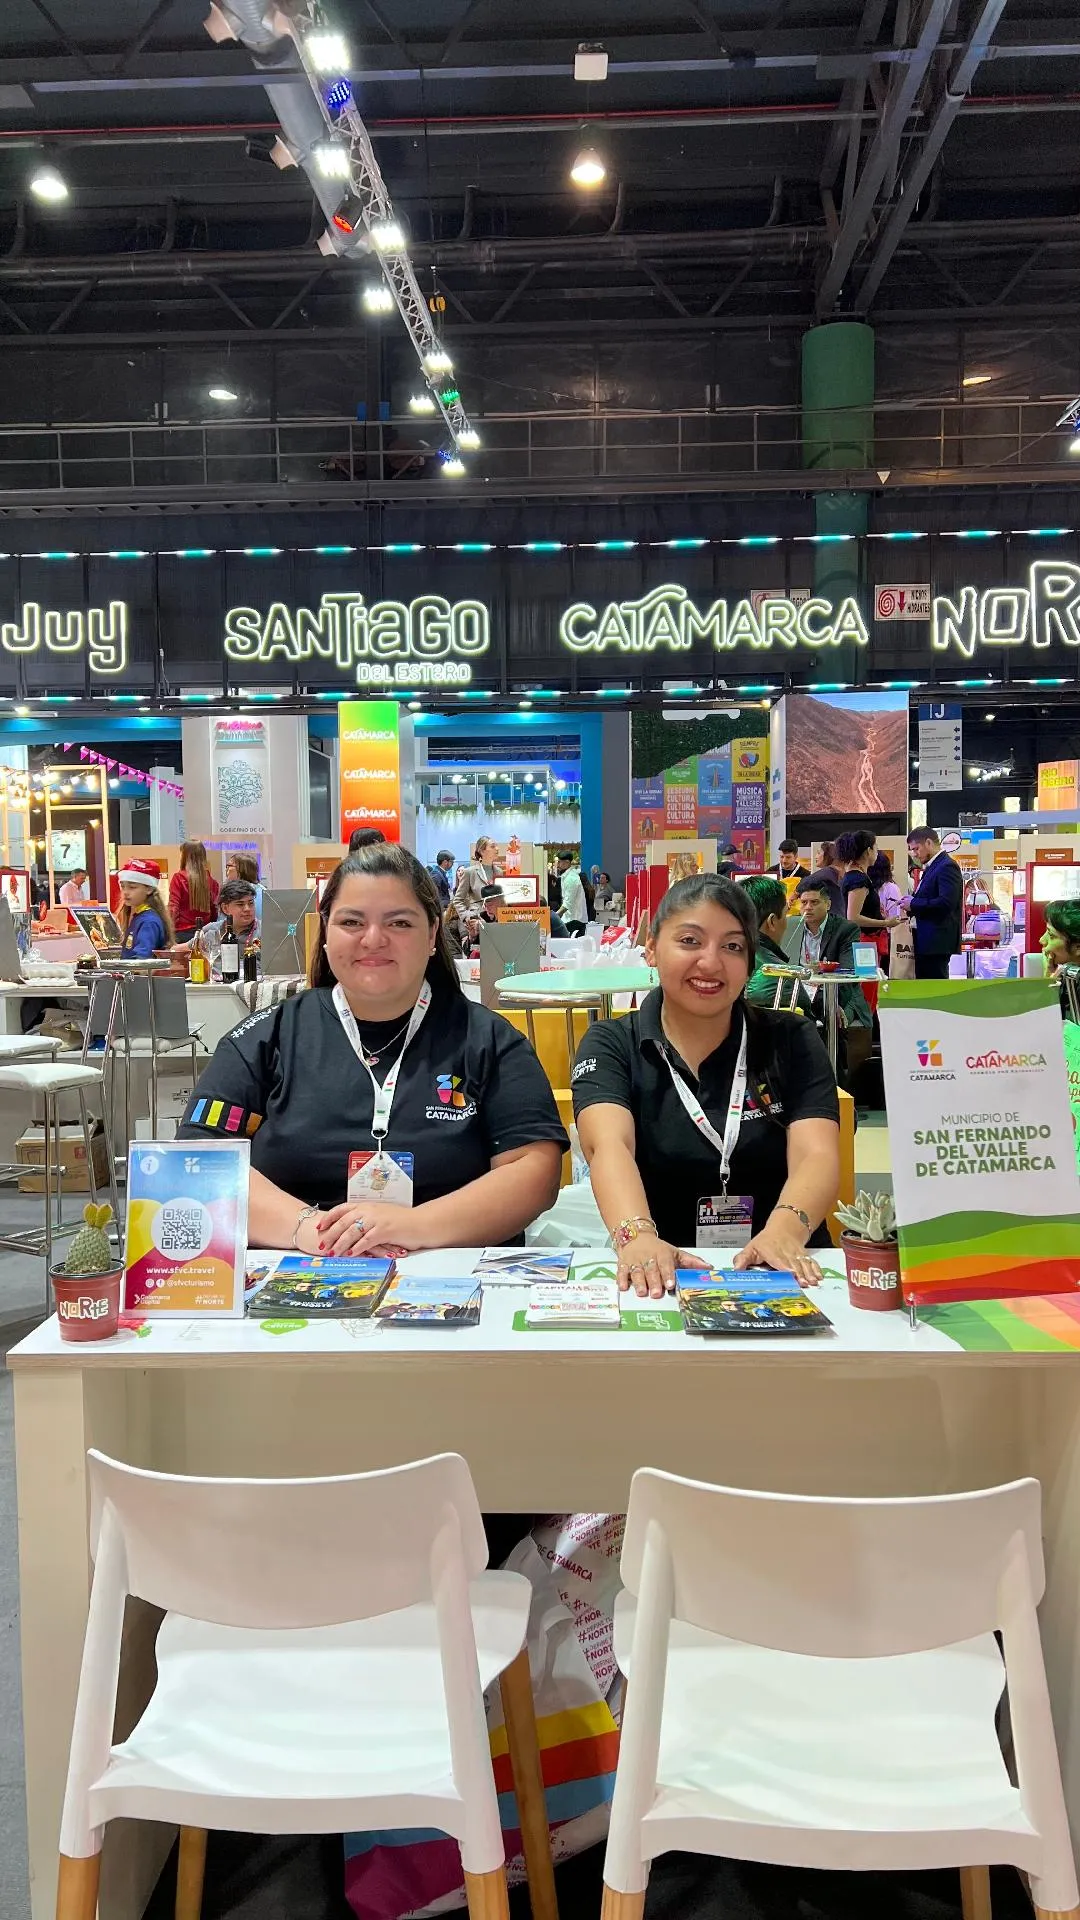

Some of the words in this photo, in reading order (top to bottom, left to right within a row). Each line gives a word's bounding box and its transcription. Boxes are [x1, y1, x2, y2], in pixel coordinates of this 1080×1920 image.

[559, 584, 869, 651] CATAMARCA
[933, 560, 1080, 657] NOR
[343, 728, 396, 740] CATAMARCA
[343, 768, 396, 779] CATAMARCA
[344, 807, 397, 818] CATAMARCA
[61, 844, 71, 859] 7
[966, 1050, 1047, 1069] CATAMARCA
[941, 1113, 1002, 1125] MUNICIPIO
[1005, 1112, 1020, 1123] DE
[913, 1129, 950, 1146] SAN
[955, 1125, 1051, 1143] FERNANDO
[936, 1144, 969, 1160] DEL
[973, 1142, 1028, 1158] VALLE
[916, 1161, 939, 1177] DE
[943, 1156, 1056, 1176] CATAMARCA
[146, 1266, 215, 1274] www.sfvc.travel
[546, 1550, 593, 1582] CATAMARCA
